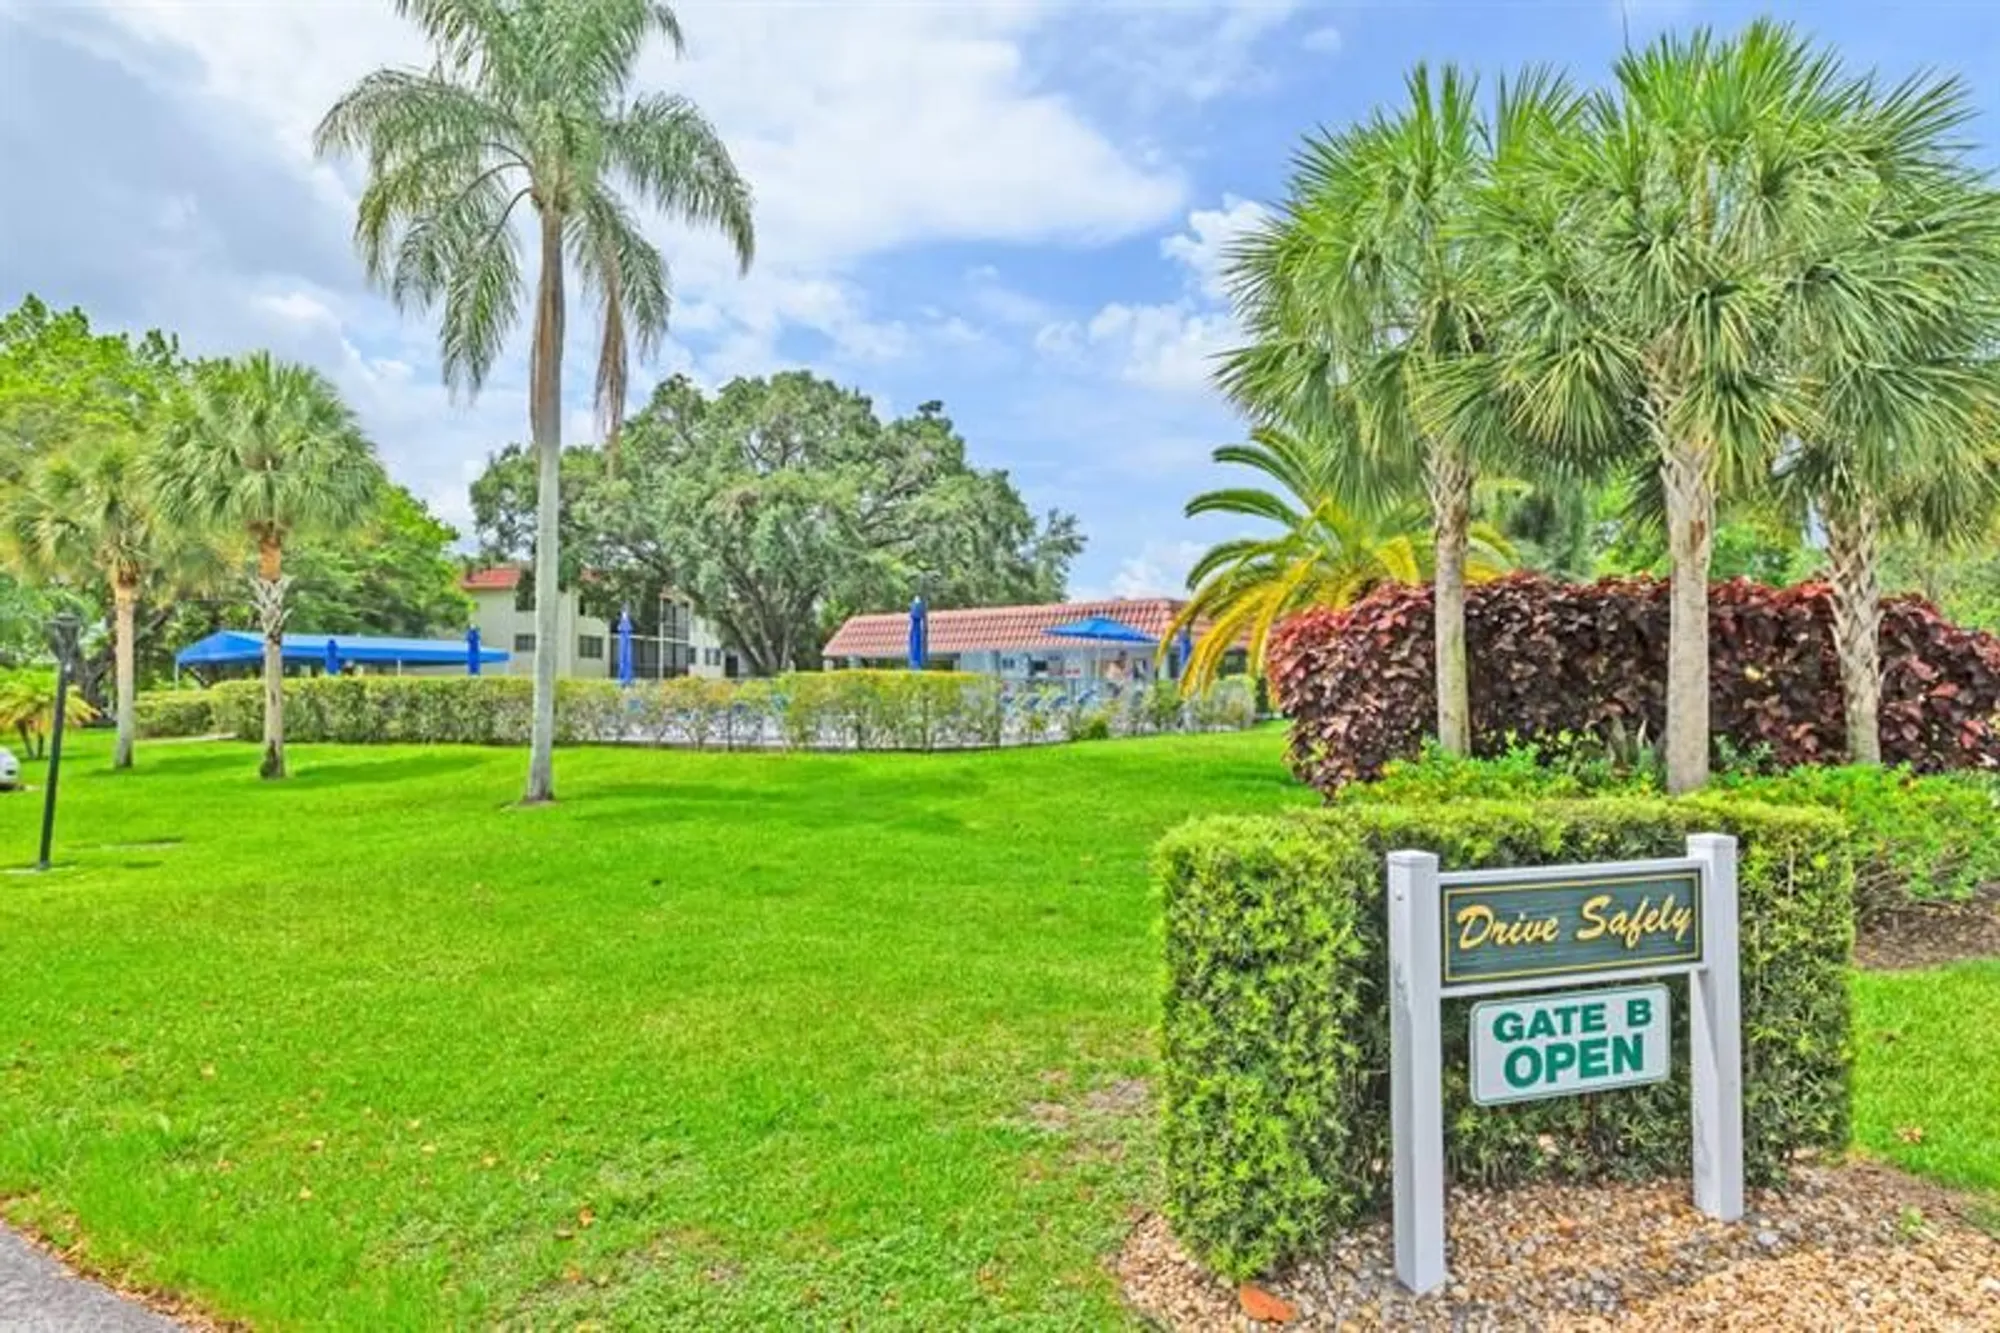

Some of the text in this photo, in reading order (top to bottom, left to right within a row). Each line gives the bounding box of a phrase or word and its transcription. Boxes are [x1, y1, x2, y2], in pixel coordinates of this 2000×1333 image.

[1456, 895, 1692, 950] Drive Safely
[1493, 999, 1652, 1042] GATE B
[1504, 1034, 1644, 1088] OPEN
